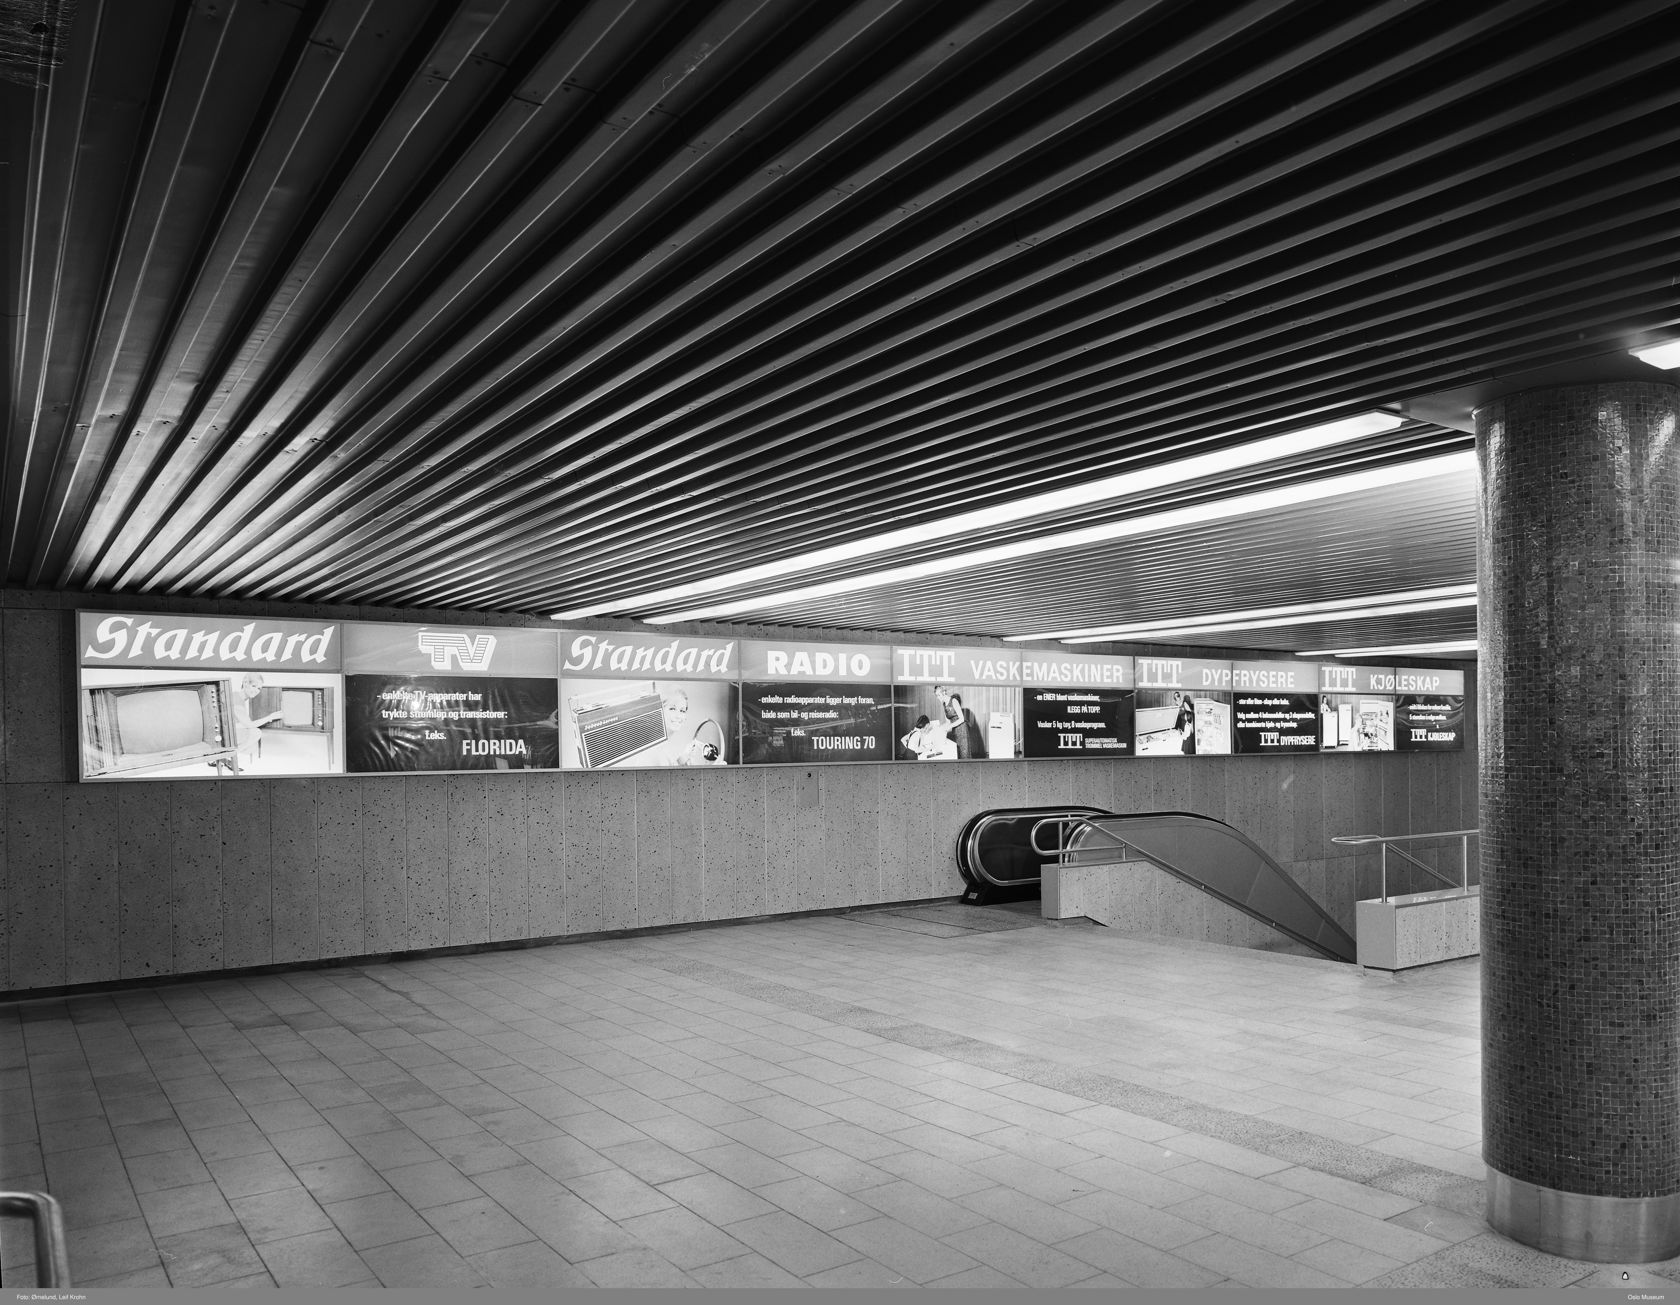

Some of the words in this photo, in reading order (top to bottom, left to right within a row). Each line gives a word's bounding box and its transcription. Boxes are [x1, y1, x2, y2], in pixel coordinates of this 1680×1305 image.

[84, 616, 335, 664] Standard
[418, 632, 497, 672] TV
[563, 635, 734, 675] Standard
[767, 650, 871, 676] RADIO
[897, 650, 956, 682] ITT
[970, 659, 1123, 683] VASKEMASKINER
[1138, 658, 1182, 688] ITT
[1202, 668, 1295, 688] DYPFRYSERE
[1321, 666, 1356, 691] ITT
[1370, 673, 1440, 691] KJØLESKAP
[468, 691, 482, 701] har
[761, 695, 783, 704] enkelte
[784, 695, 825, 705] radioapparater
[826, 696, 842, 706] ligger
[843, 696, 857, 706] langt
[858, 696, 875, 704] foran,
[382, 709, 407, 721] trykte
[448, 711, 458, 720] og
[460, 709, 508, 719] transistorer:
[761, 710, 776, 719] både
[777, 711, 790, 719] som
[801, 712, 808, 720] og
[809, 710, 839, 719] reiseradio:
[1081, 704, 1088, 713] PÅ
[1053, 720, 1056, 728] 5
[1057, 720, 1062, 729] kg
[1058, 733, 1083, 748] ITT
[1259, 732, 1279, 746] ITT
[1280, 735, 1316, 746] DYPFRYSERE
[1410, 729, 1427, 741] ITT
[462, 739, 527, 756] FLORIDA
[812, 736, 861, 750] TOURING
[862, 736, 876, 749] 70
